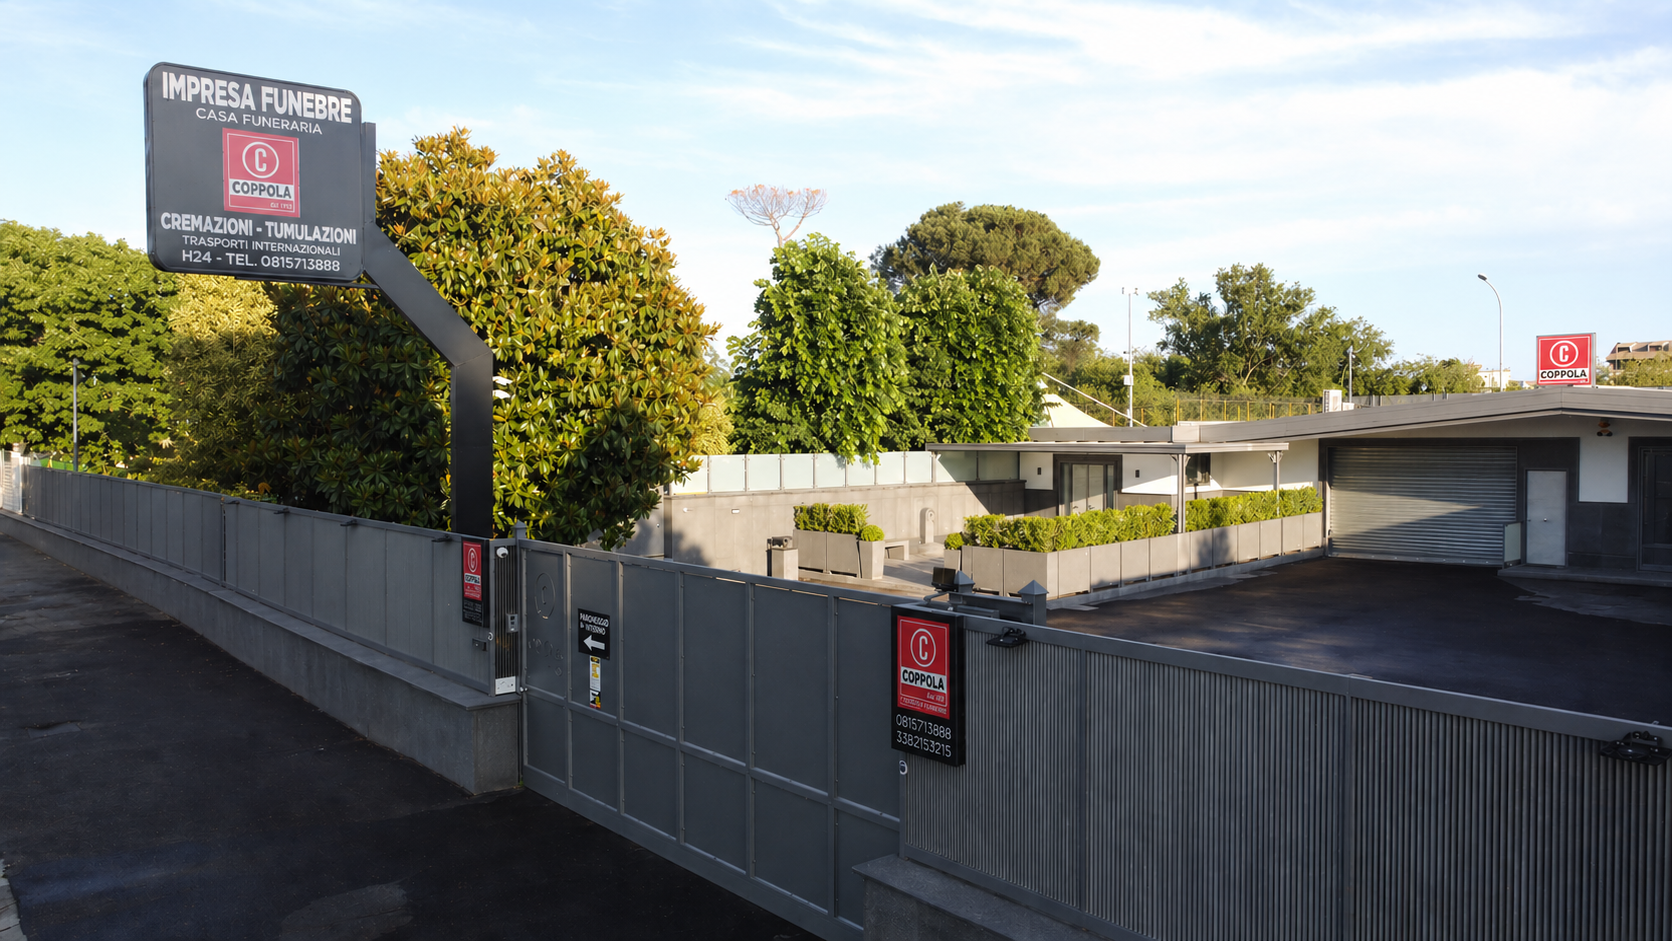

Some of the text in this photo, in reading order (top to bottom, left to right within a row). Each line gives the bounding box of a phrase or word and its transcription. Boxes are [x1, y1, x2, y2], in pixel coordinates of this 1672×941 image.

[162, 71, 353, 123] IMPRESA FUNEBRE
[196, 108, 322, 134] CASA FUNERARIA
[255, 148, 267, 172] C
[232, 180, 292, 199] COPPOLA
[160, 212, 253, 236] CREMAZIONI
[265, 221, 357, 244] TUMULAZIONI
[182, 235, 341, 256] TRASPORTI INTERNAZIONALI
[182, 250, 212, 263] H24
[226, 253, 257, 267] TEL.
[261, 256, 340, 271] 0815713888
[1559, 345, 1569, 362] C
[1540, 369, 1587, 379] COPPOLA
[919, 635, 928, 661] C
[902, 669, 944, 691] COPPOLA
[895, 713, 952, 740] 0815713888
[896, 730, 952, 758] 3382153215
